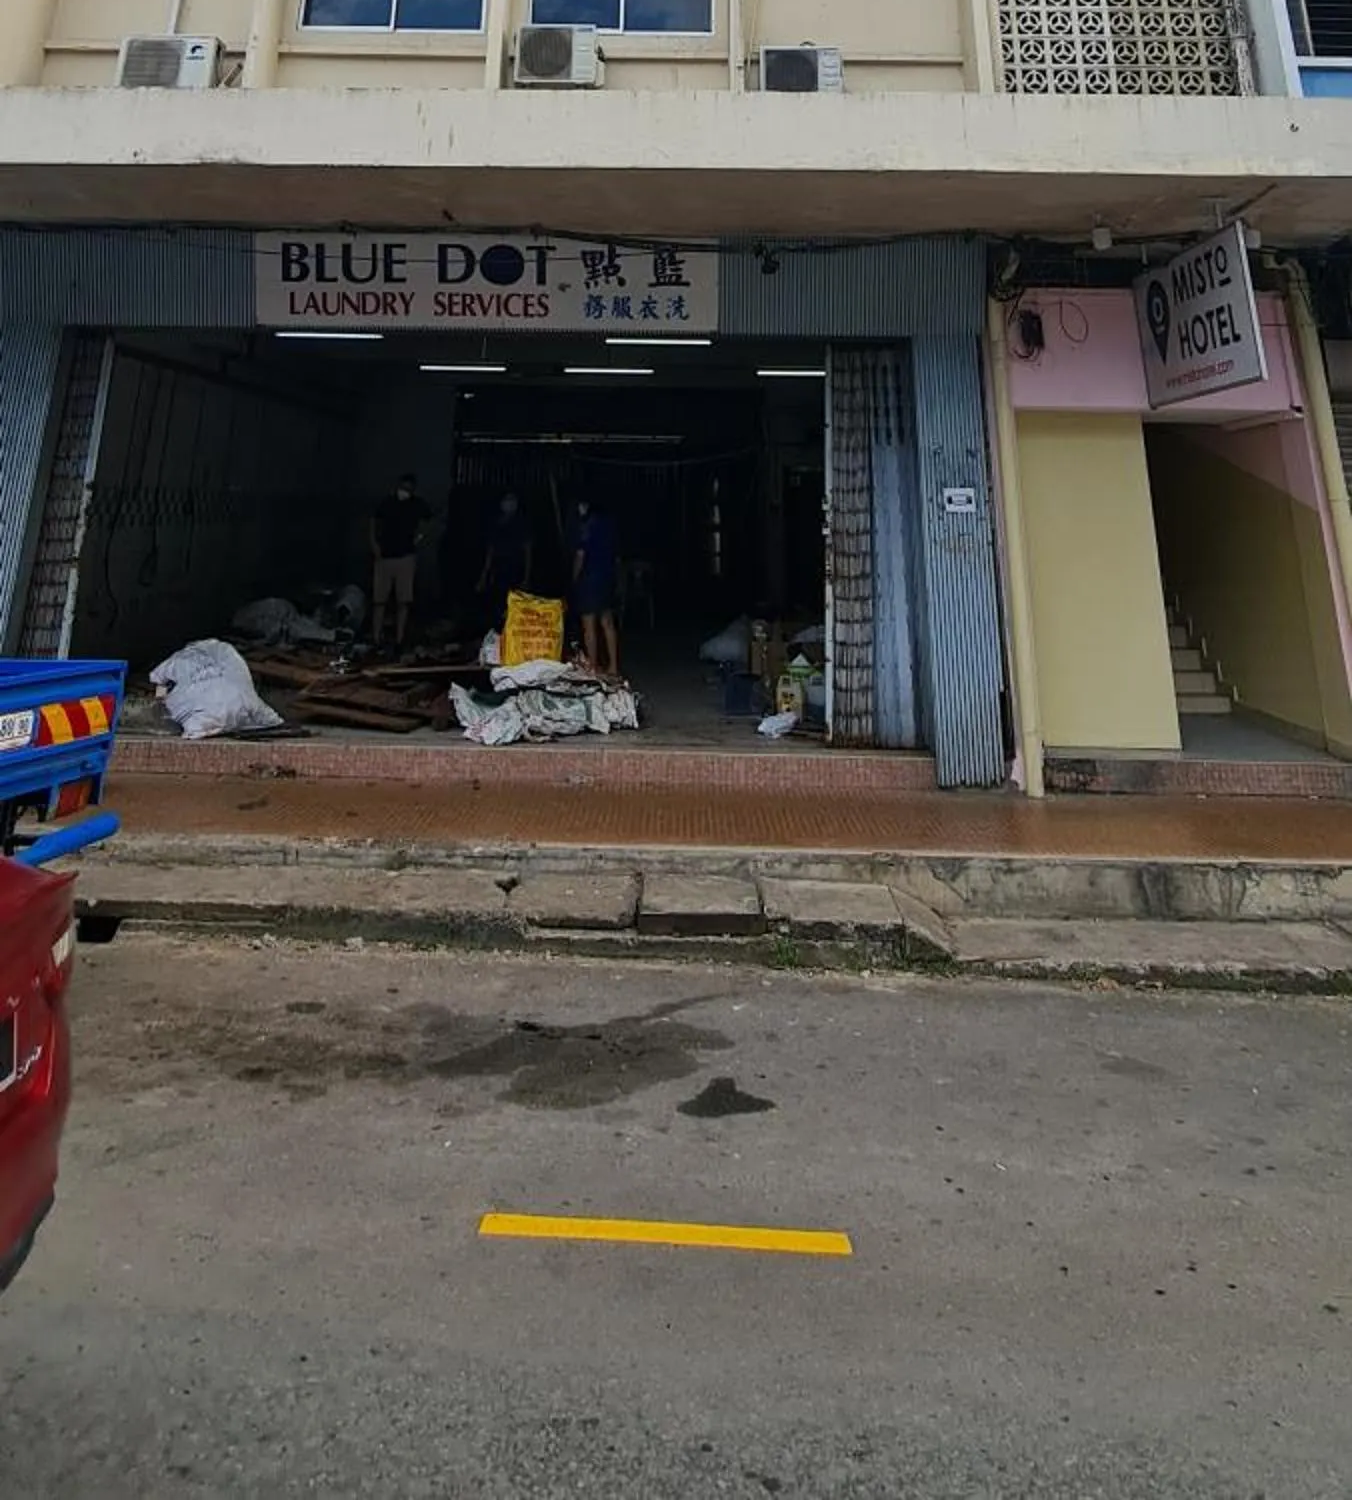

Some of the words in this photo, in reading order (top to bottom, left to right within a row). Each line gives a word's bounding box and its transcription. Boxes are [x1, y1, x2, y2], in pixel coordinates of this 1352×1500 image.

[281, 242, 407, 283] BLUE
[437, 243, 556, 286] DOT
[1171, 245, 1231, 307] MISTO
[289, 291, 415, 317] LAUNDRY
[433, 291, 549, 318] SERVICES
[1177, 303, 1241, 360] HOTEL
